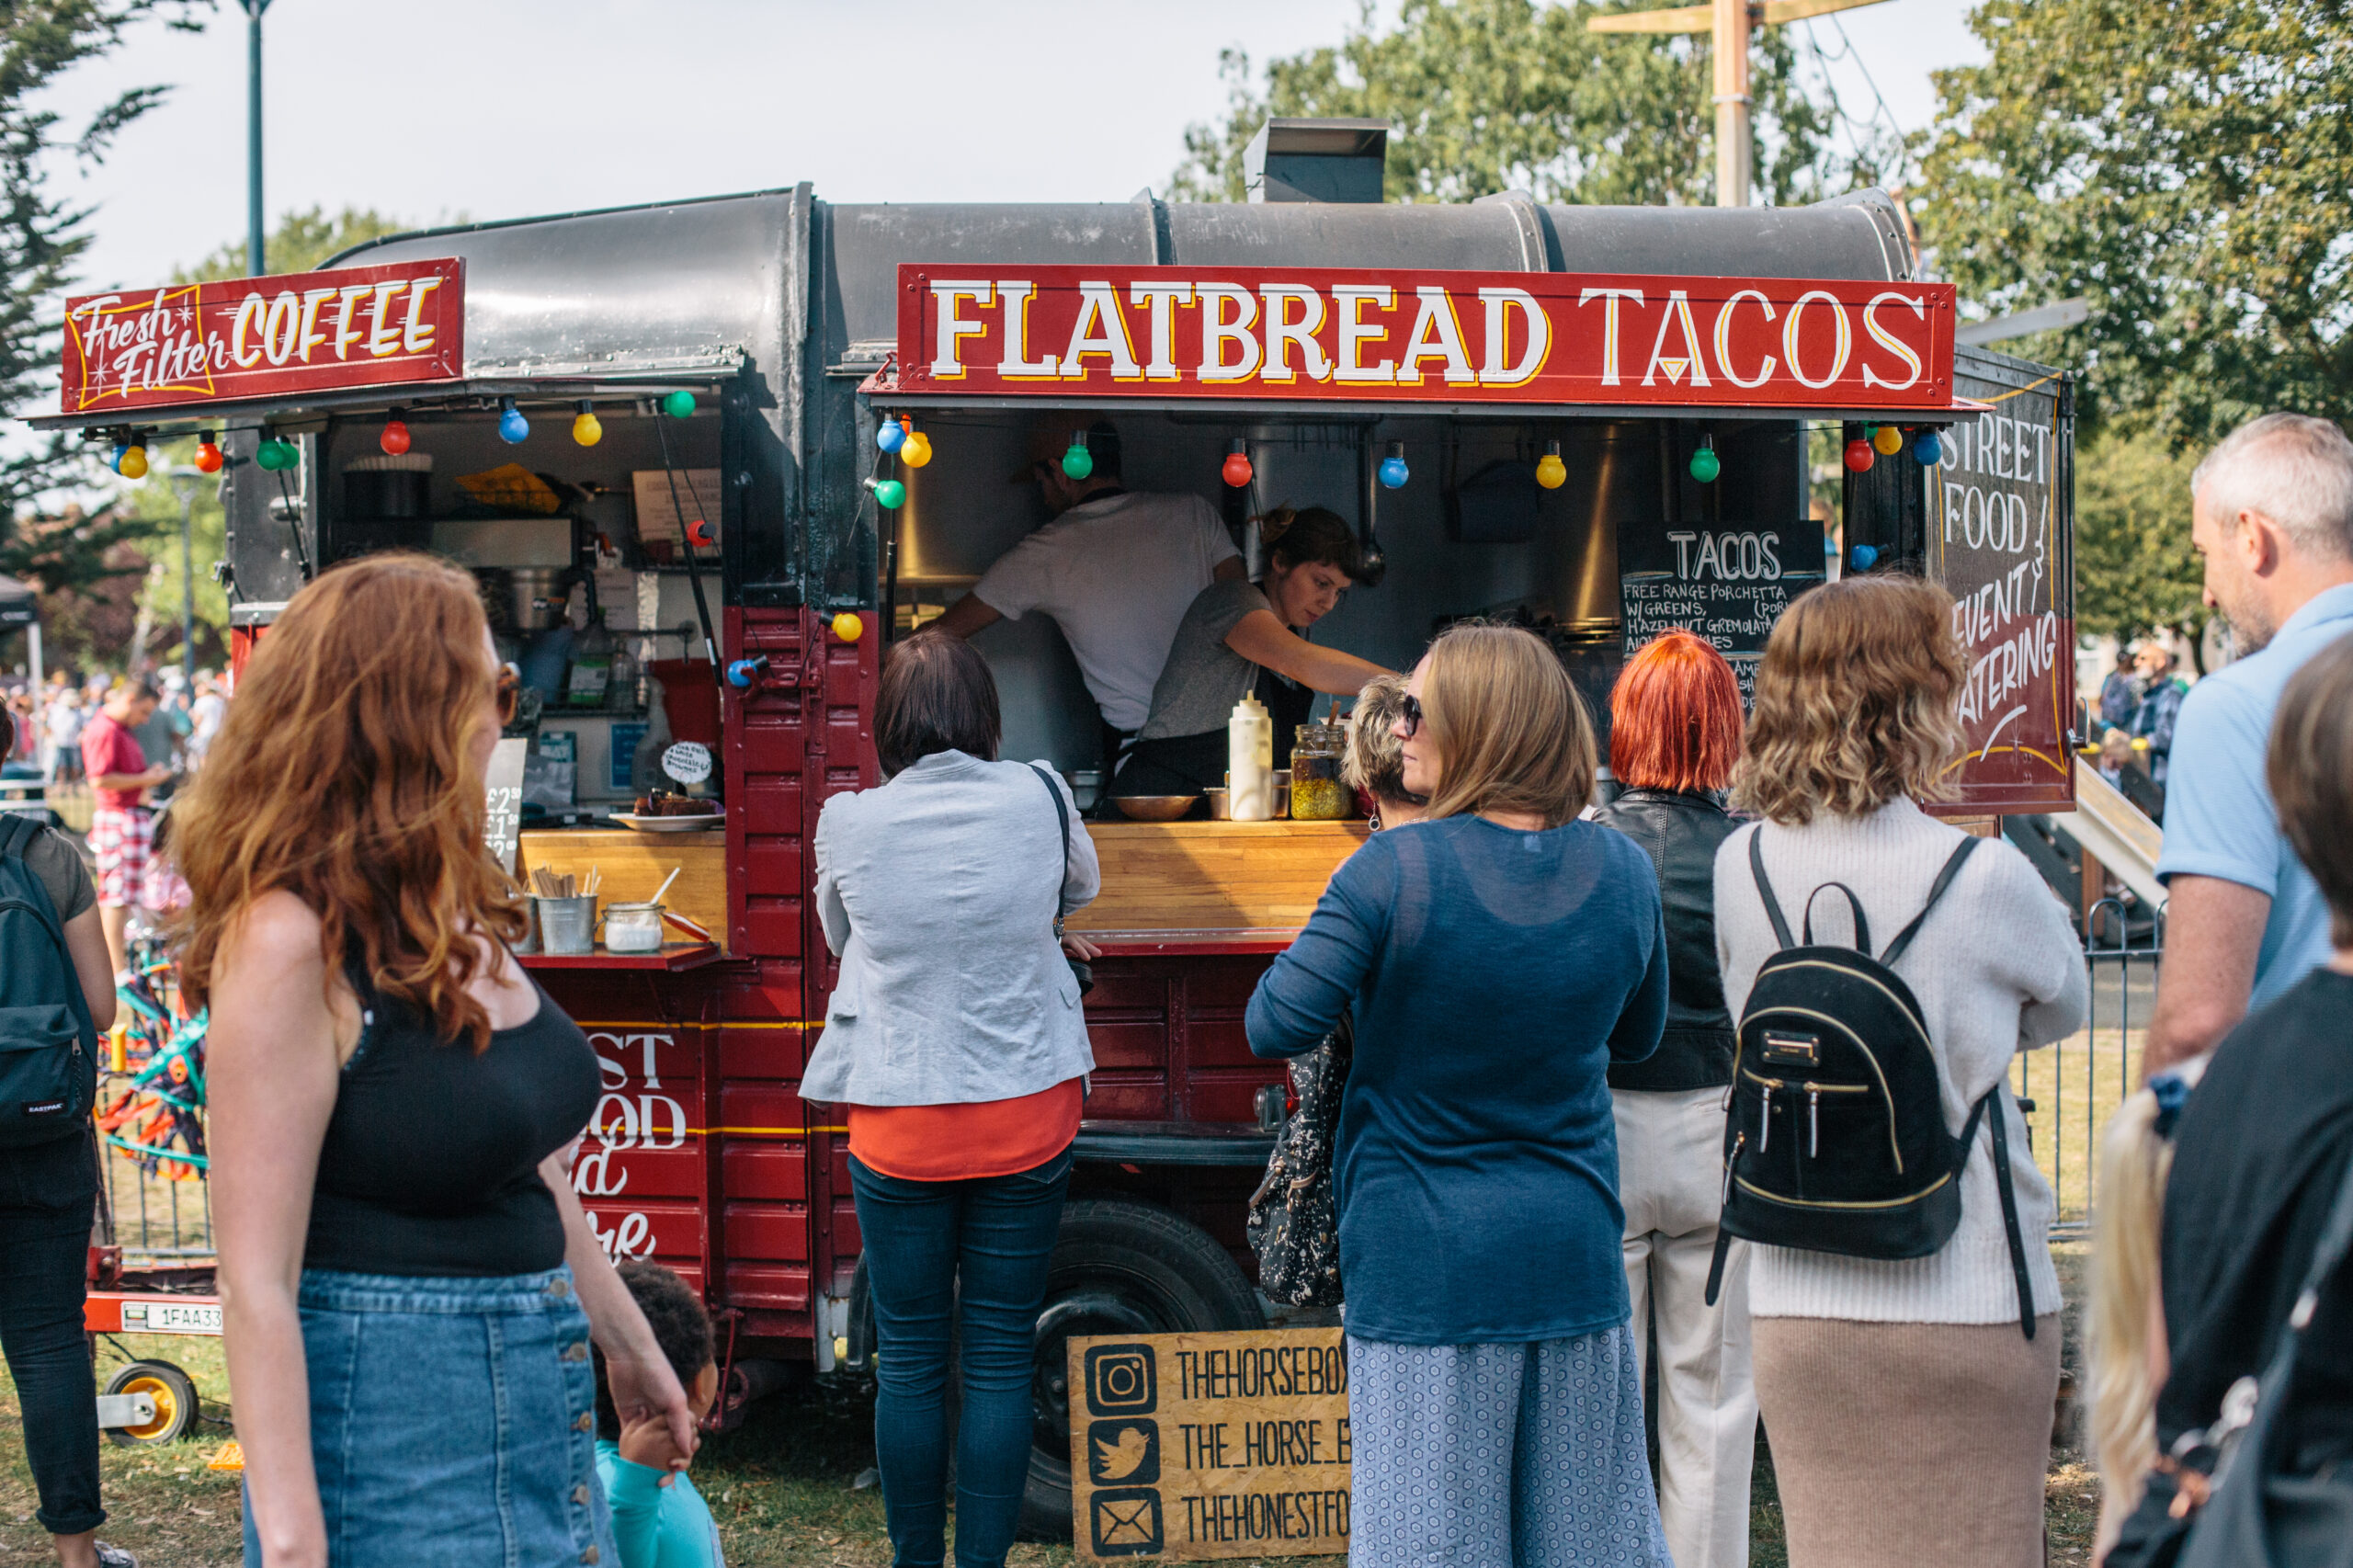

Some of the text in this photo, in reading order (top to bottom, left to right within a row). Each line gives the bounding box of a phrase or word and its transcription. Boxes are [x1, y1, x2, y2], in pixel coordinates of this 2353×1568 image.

[71, 289, 177, 358] Fresh
[232, 276, 444, 369] COFFEE
[929, 279, 1926, 391] FLATBREAD TACOS
[113, 330, 229, 399] Filter
[1938, 411, 2050, 484] STREET
[1944, 482, 2028, 553] FOOD
[1666, 530, 1781, 581] TACOS
[1624, 583, 1788, 601] FREE RANGE PORCHETTA
[1951, 560, 2029, 648] EVENT
[1953, 609, 2057, 725] ATERING
[28, 1102, 64, 1113] EASTPAK
[1181, 1489, 1351, 1543] THEHONESTFO
